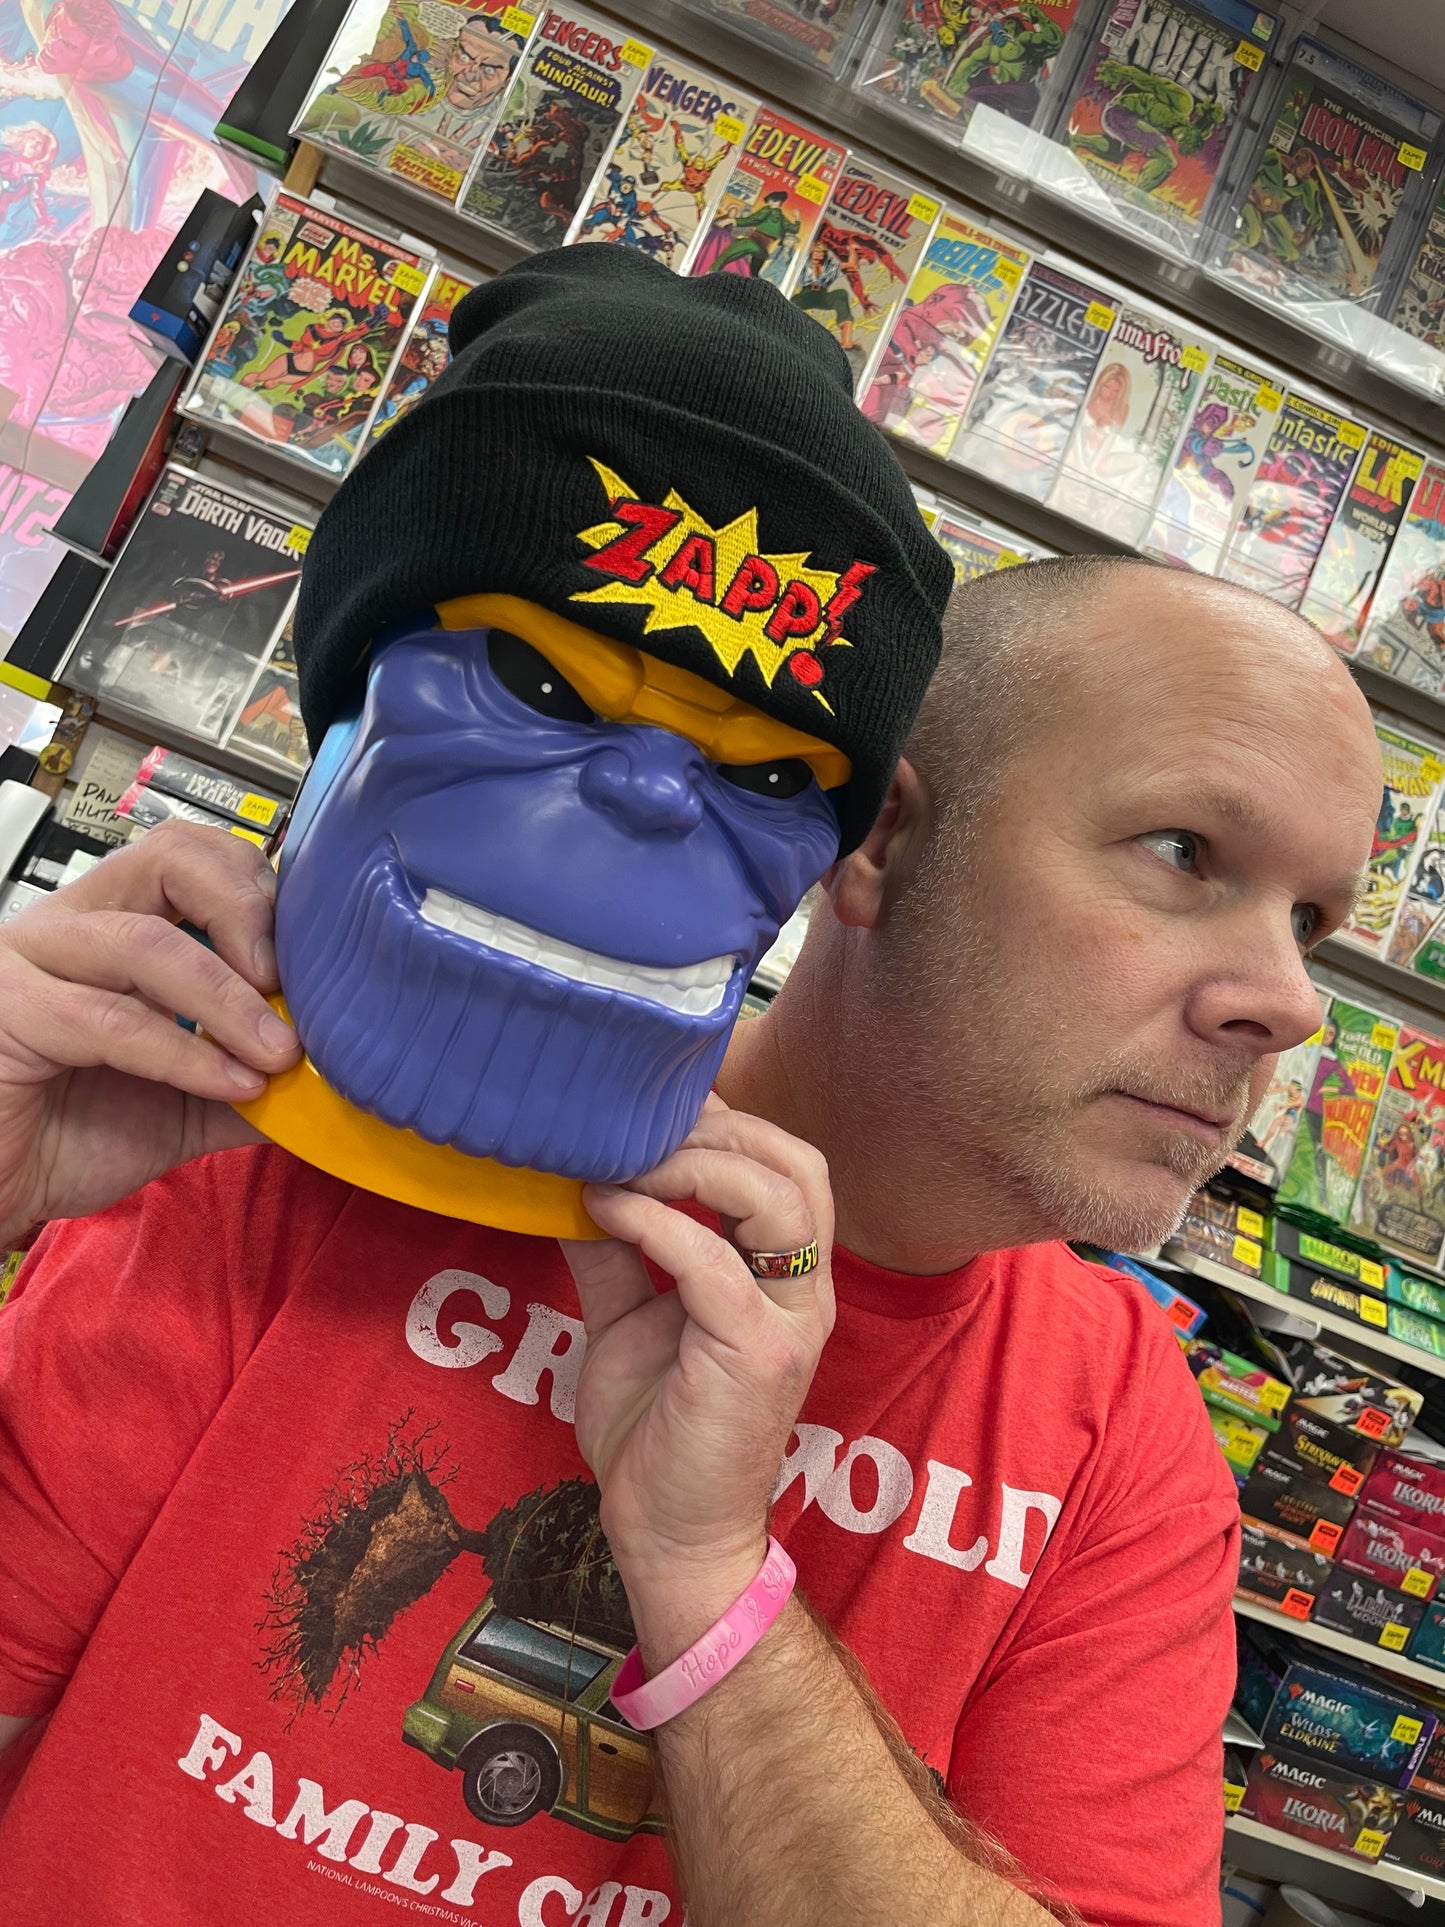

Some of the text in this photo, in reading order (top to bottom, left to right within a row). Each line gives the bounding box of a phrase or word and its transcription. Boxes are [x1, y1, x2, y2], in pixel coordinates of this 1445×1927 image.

[534, 59, 616, 109] MINOTAUR!
[546, 50, 615, 89] FOUR AGAINST
[1322, 97, 1402, 149] THE INVINCIBL
[1301, 102, 1408, 190] IRON MAN
[283, 242, 399, 313] MARVEL
[331, 236, 378, 274] Ms.
[177, 490, 245, 535] DARTH
[582, 500, 880, 688] ZAPP!
[680, 1630, 743, 1690] Hope
[1300, 1689, 1353, 1716] MAGIC
[1279, 1722, 1338, 1754] ELDRAINE
[1290, 1712, 1333, 1740] WILDS
[1272, 1760, 1328, 1790] MAGIC
[1406, 1735, 1426, 1771] BUNDLE
[177, 1713, 515, 1907] FAMILY
[1282, 1797, 1347, 1834] IKORIA
[306, 1858, 354, 1888] NATIONAL
[353, 1879, 409, 1910] LAMPOON'S
[408, 1899, 460, 1925] CHRISTMAS
